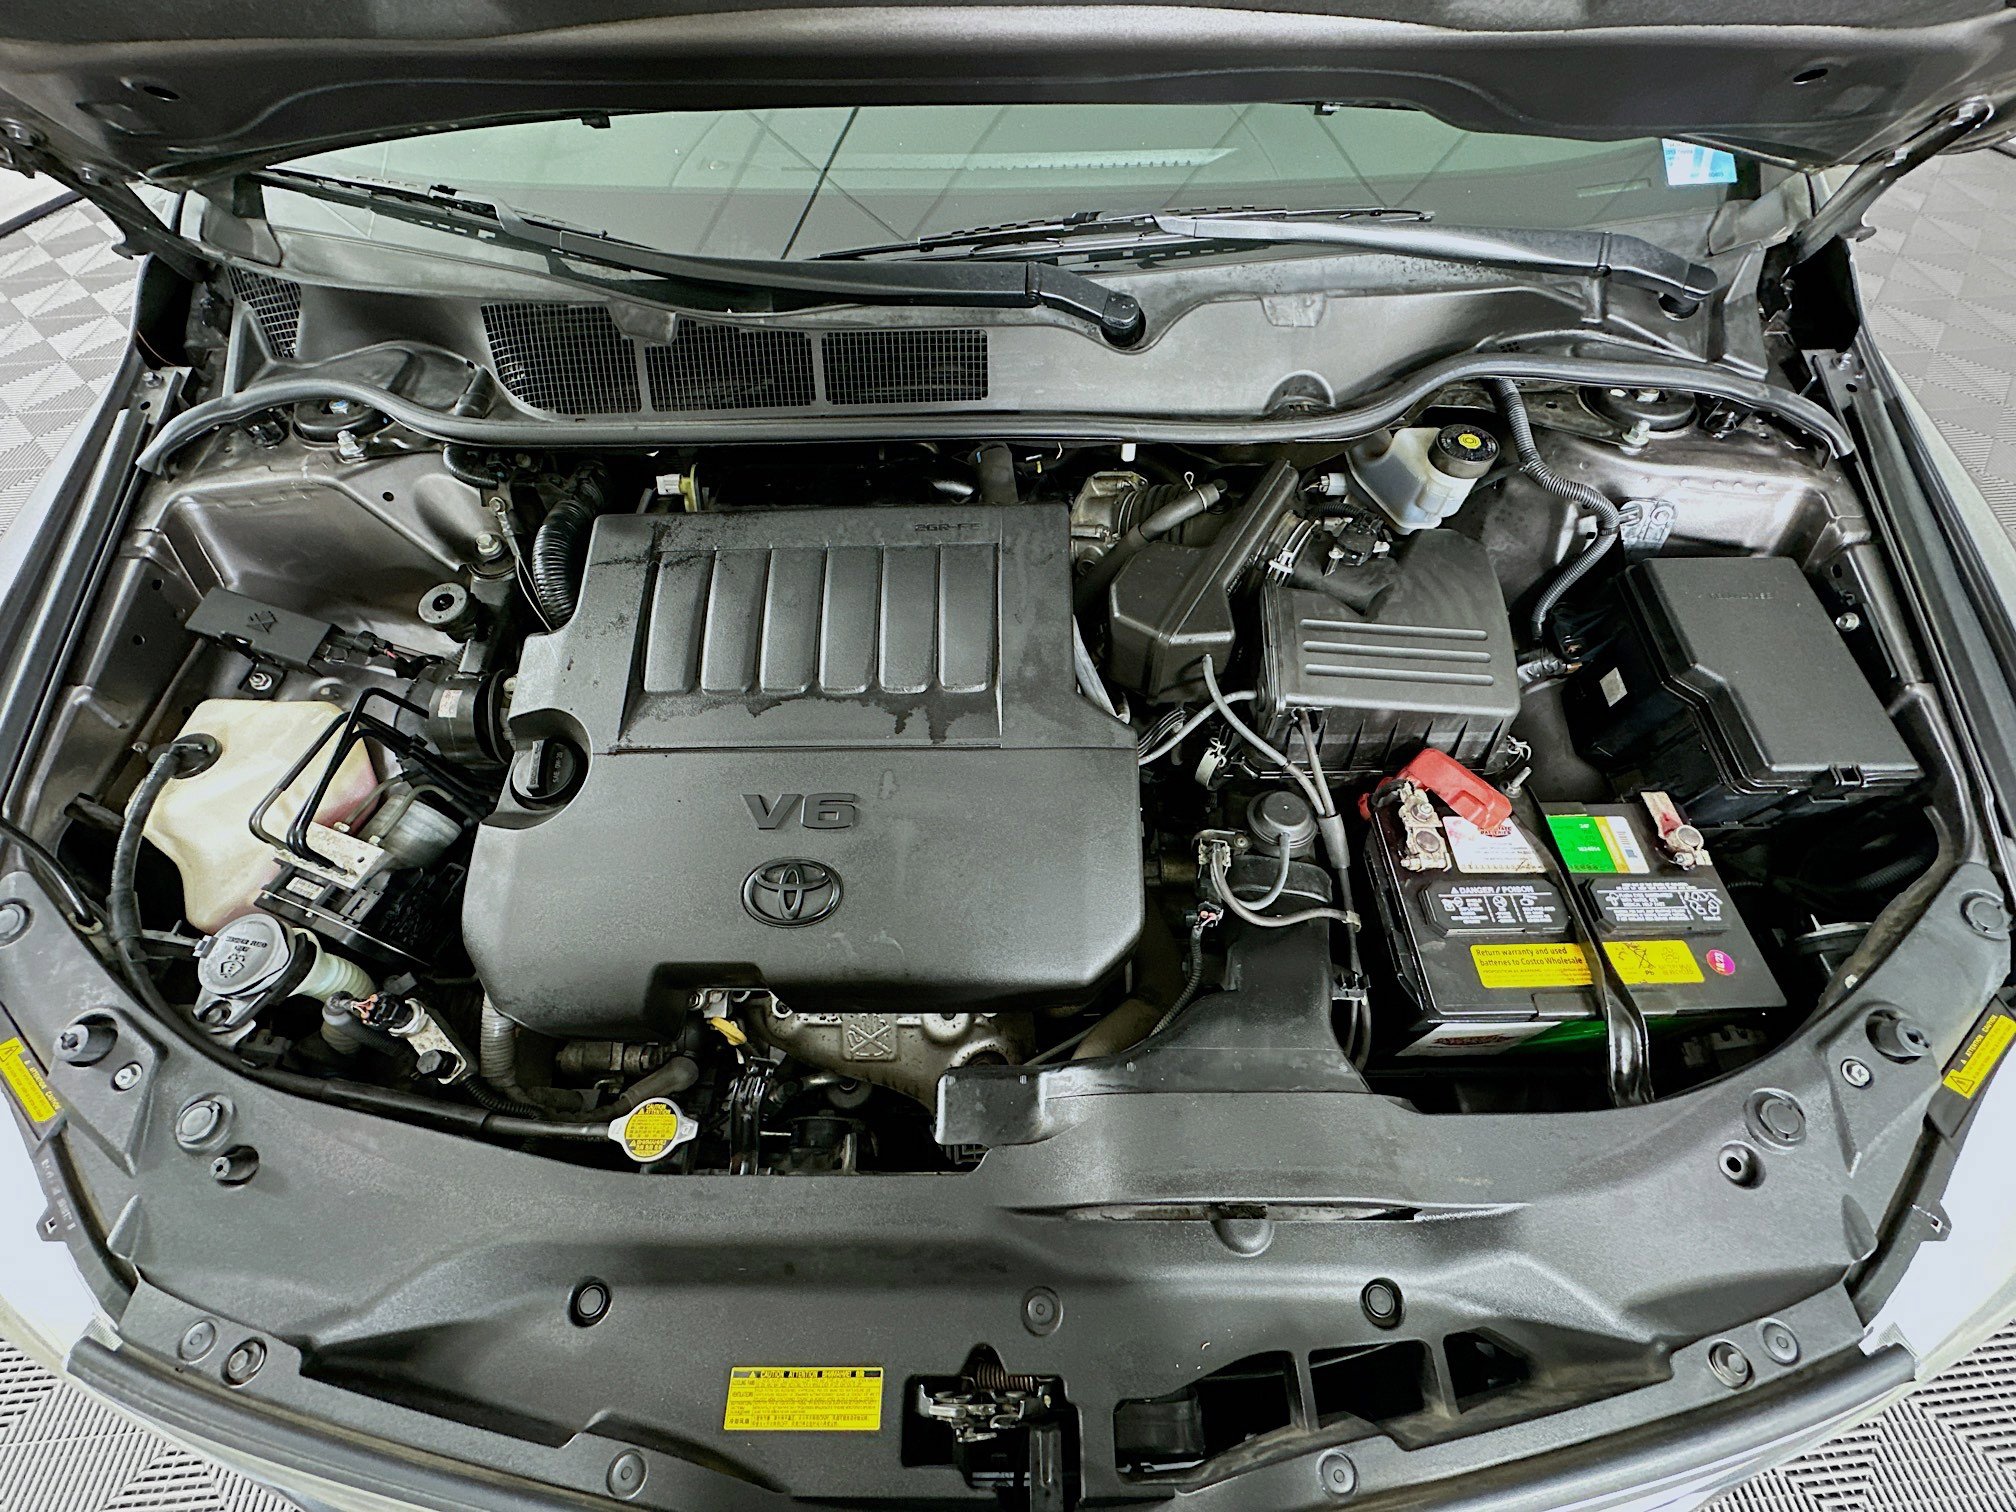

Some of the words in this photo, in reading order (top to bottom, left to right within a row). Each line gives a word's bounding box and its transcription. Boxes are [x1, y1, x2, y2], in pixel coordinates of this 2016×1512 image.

[741, 792, 857, 830] V6
[1459, 886, 1495, 894] DANGER
[1501, 885, 1535, 893] POISON
[1476, 949, 1500, 957] Return
[1502, 949, 1534, 957] warranty
[1480, 958, 1511, 966] batteries
[1521, 958, 1545, 966] Costco
[1546, 956, 1583, 965] Wholesale
